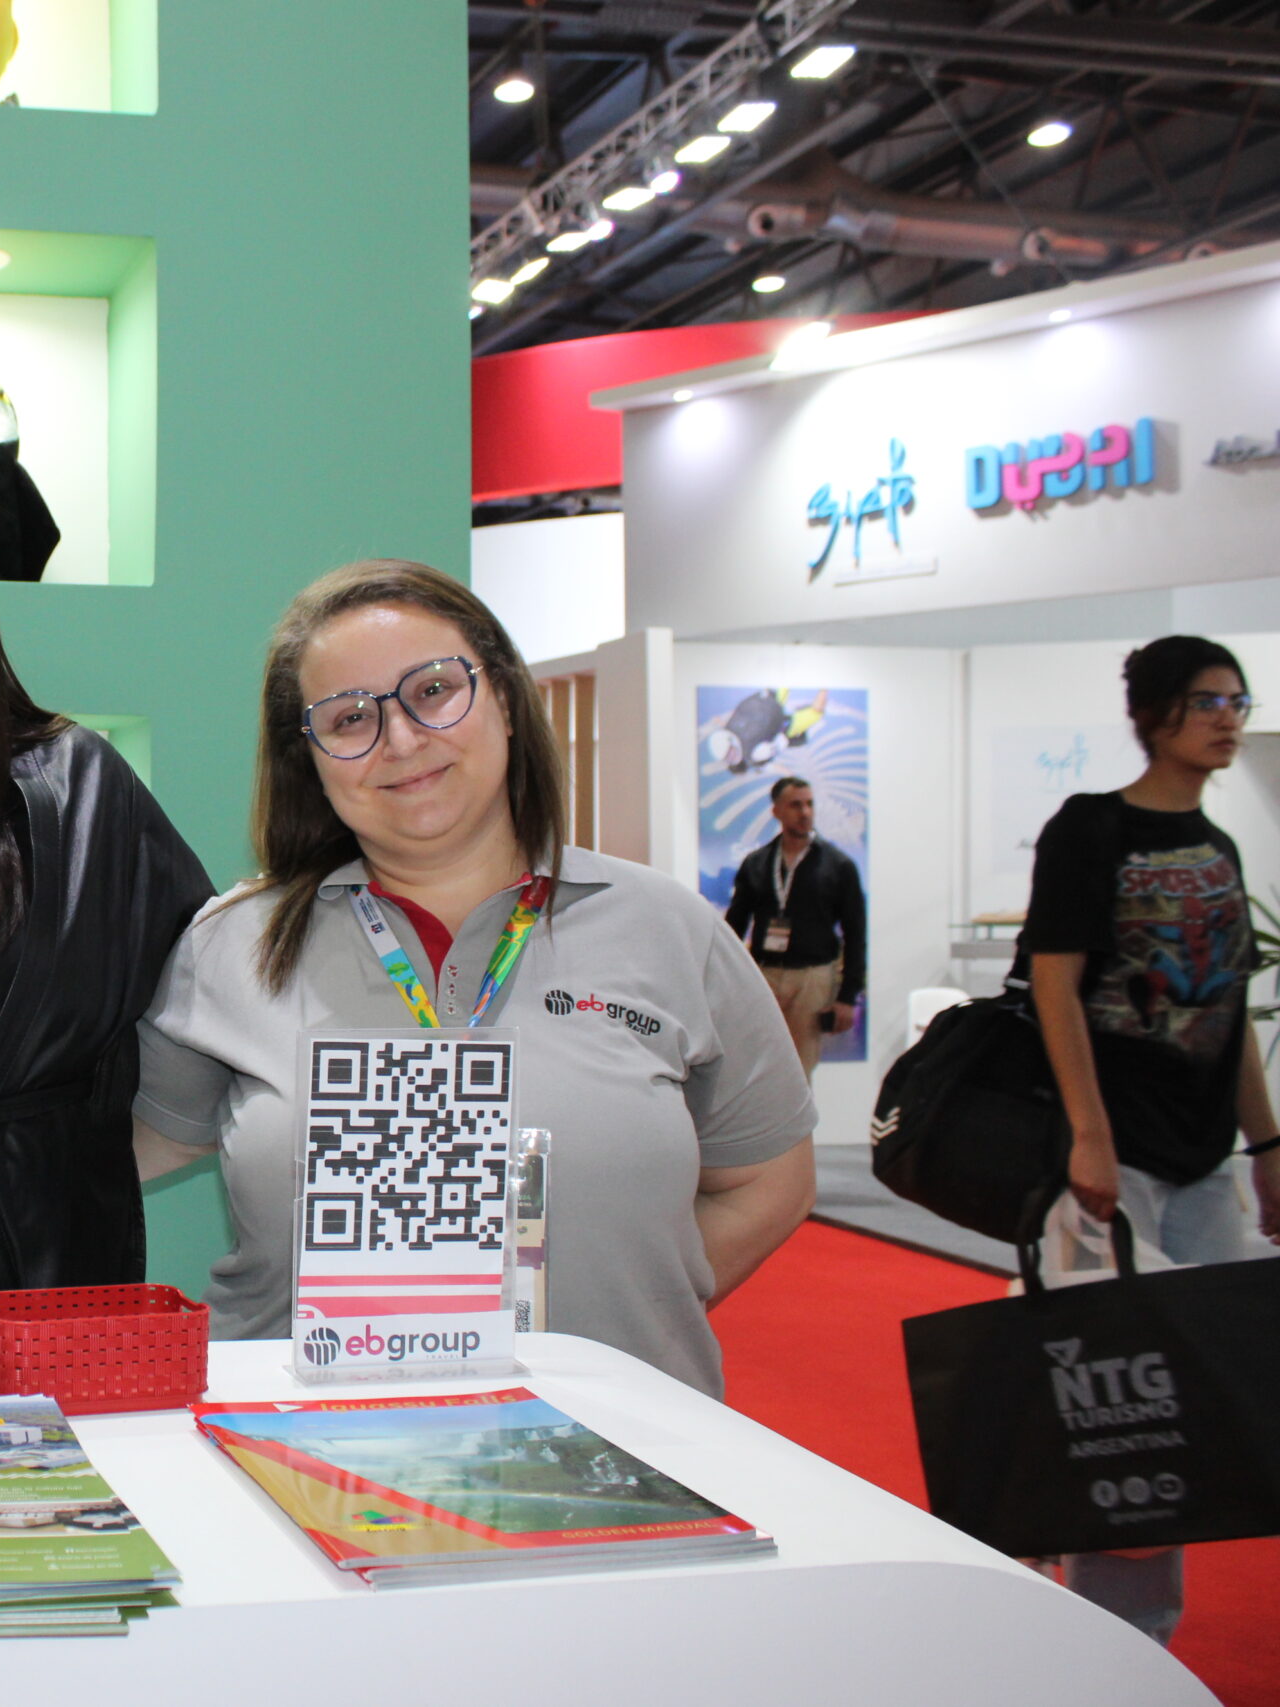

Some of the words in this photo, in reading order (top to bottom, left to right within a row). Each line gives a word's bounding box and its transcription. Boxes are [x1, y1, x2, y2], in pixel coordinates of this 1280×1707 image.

[345, 1323, 481, 1362] ebgroup
[1049, 1352, 1177, 1412] NTG
[443, 1395, 517, 1407] Falls
[1060, 1399, 1180, 1431] TURISMO
[1069, 1431, 1188, 1459] ARGENTINA
[639, 1522, 713, 1533] MANUAL
